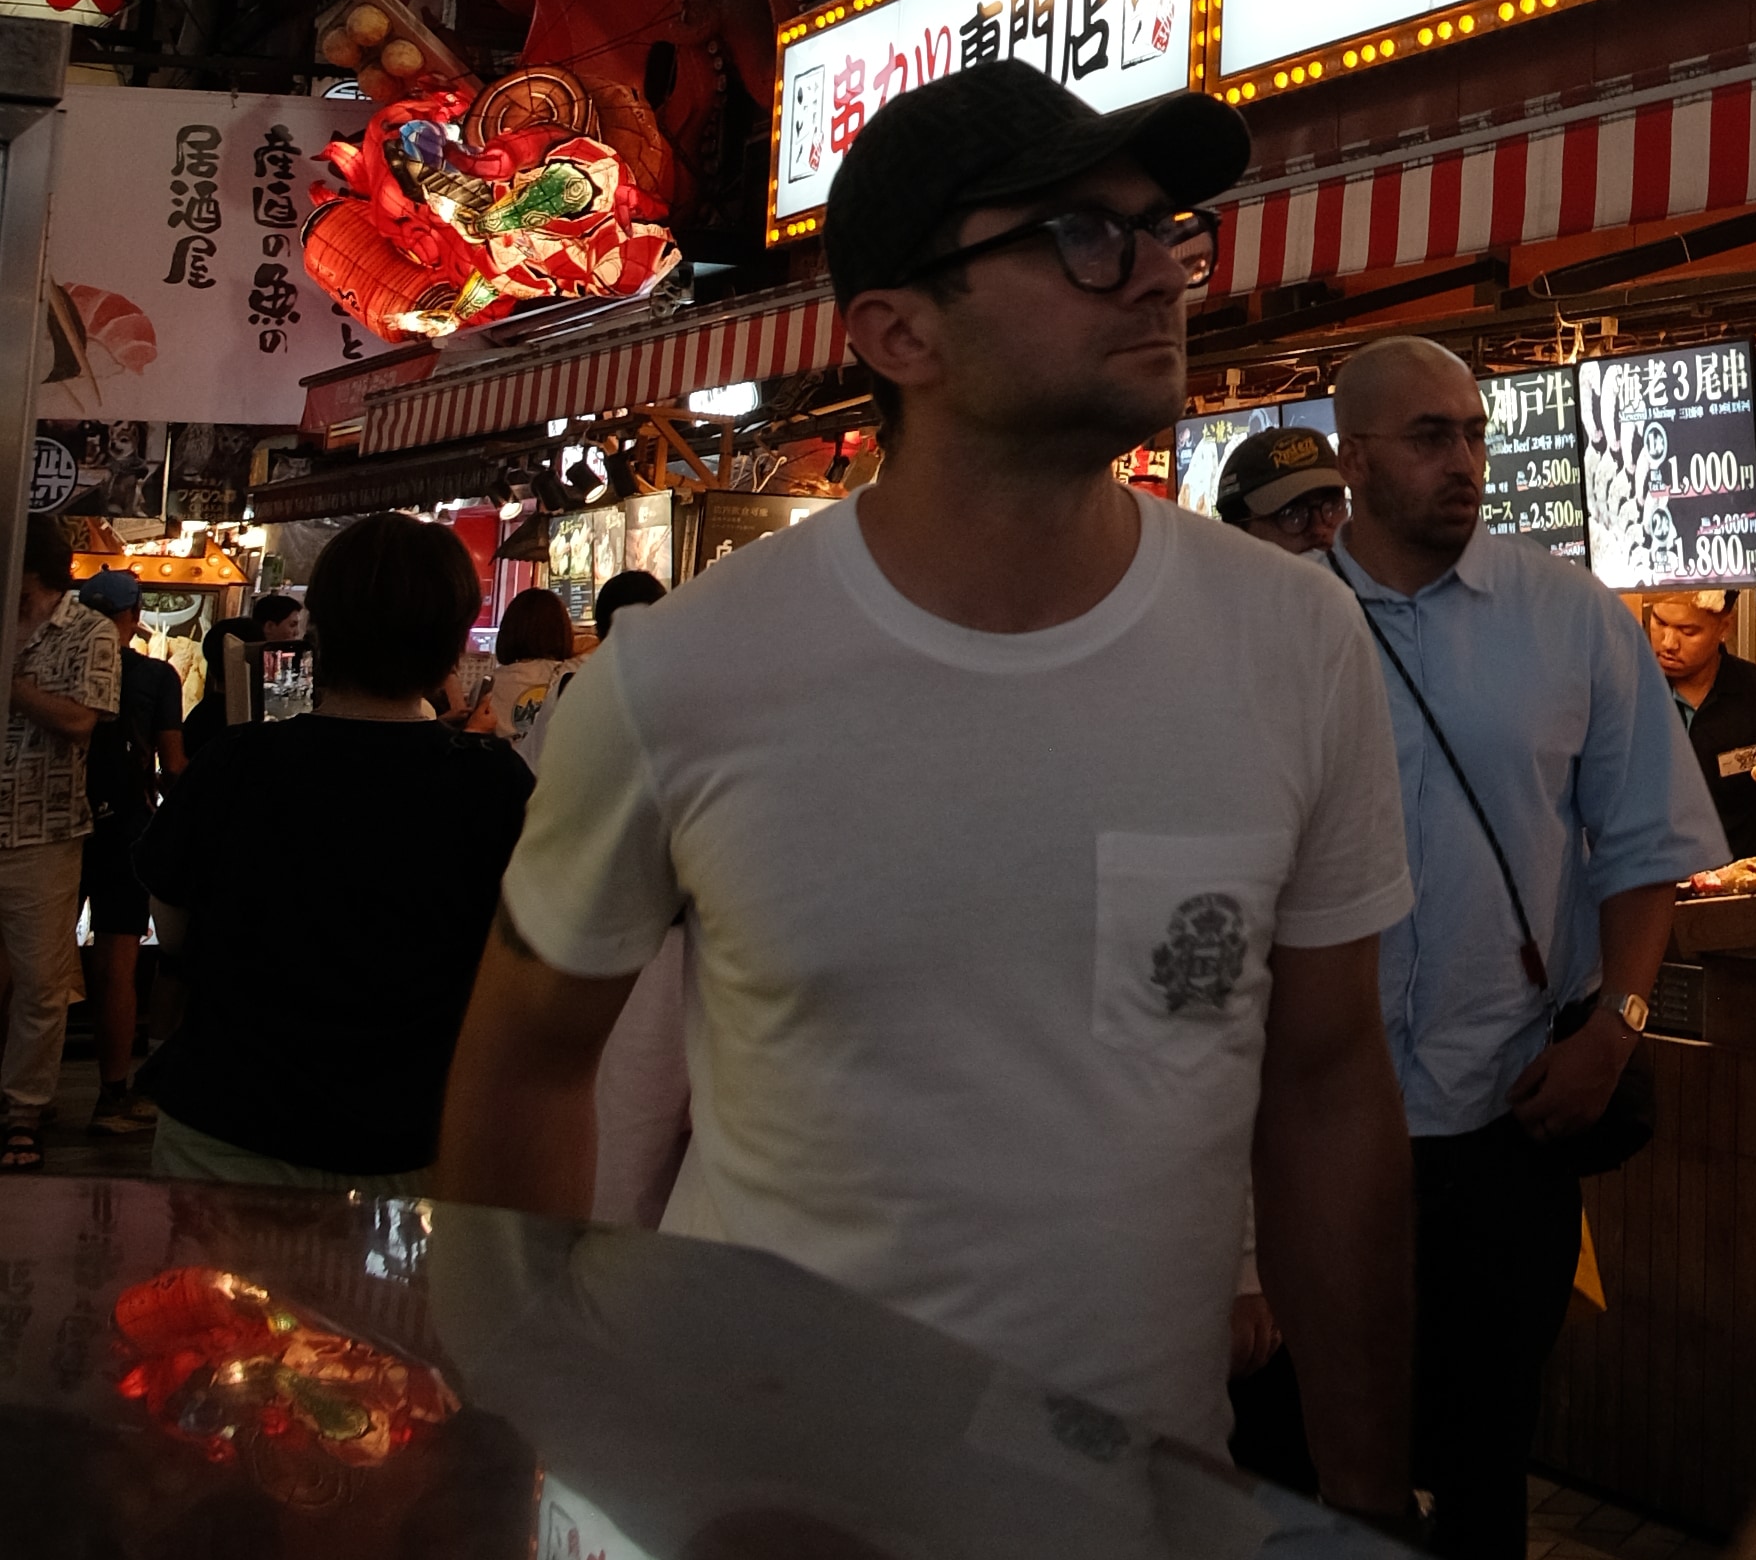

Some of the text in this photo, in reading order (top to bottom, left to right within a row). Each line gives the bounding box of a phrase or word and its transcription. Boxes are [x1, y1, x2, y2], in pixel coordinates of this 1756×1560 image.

[164, 123, 224, 290] 居酒屋
[249, 123, 302, 355] 産直の魚の
[1617, 349, 1748, 409] 海老3尾串
[1526, 457, 1581, 488] 2,500円
[1668, 450, 1756, 495] 1,000円
[1480, 500, 1514, 522] ロース
[1530, 499, 1584, 530] 2,500円
